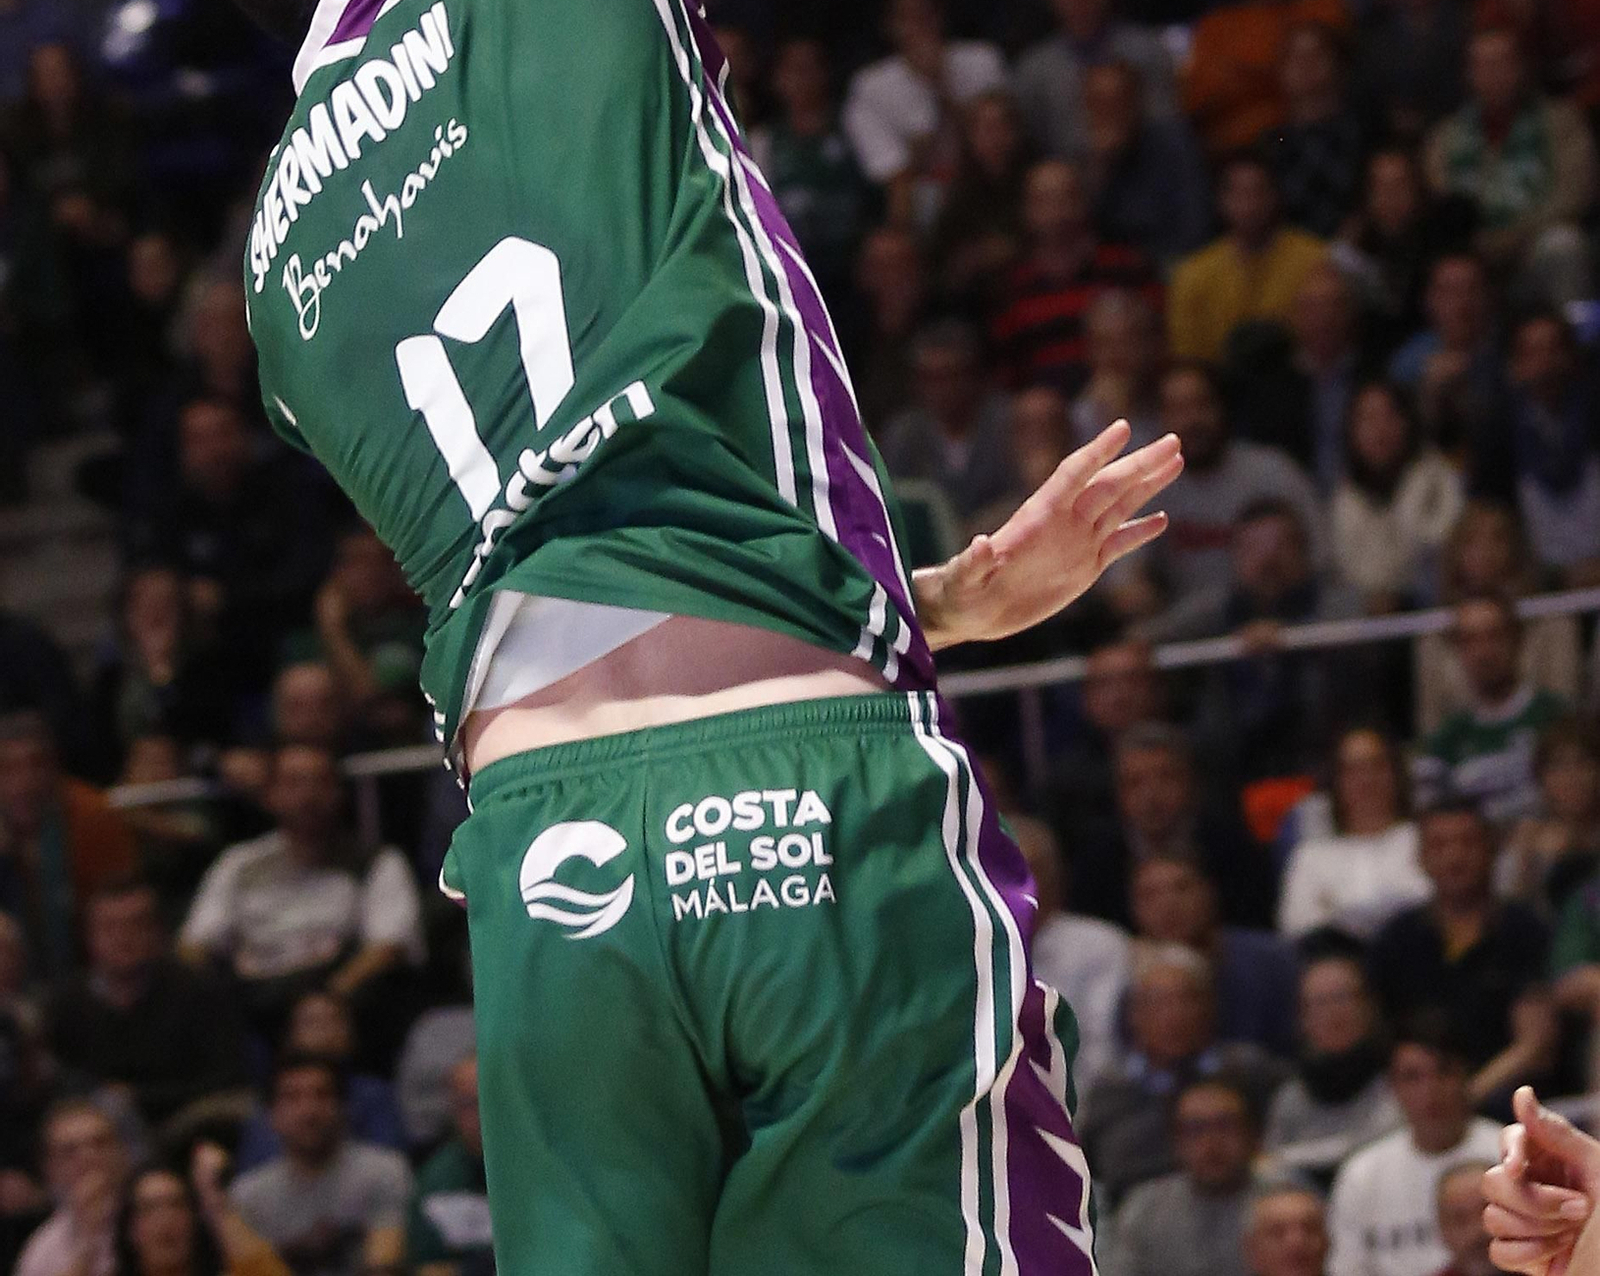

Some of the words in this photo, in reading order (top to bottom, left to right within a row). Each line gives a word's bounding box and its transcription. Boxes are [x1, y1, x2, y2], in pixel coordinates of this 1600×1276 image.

[250, 1, 456, 293] SHERMADINI
[395, 236, 575, 523] 17
[665, 789, 832, 844] COSTA
[665, 841, 742, 886] DEL
[749, 831, 834, 871] SOL
[670, 873, 837, 921] MÁLAGA
